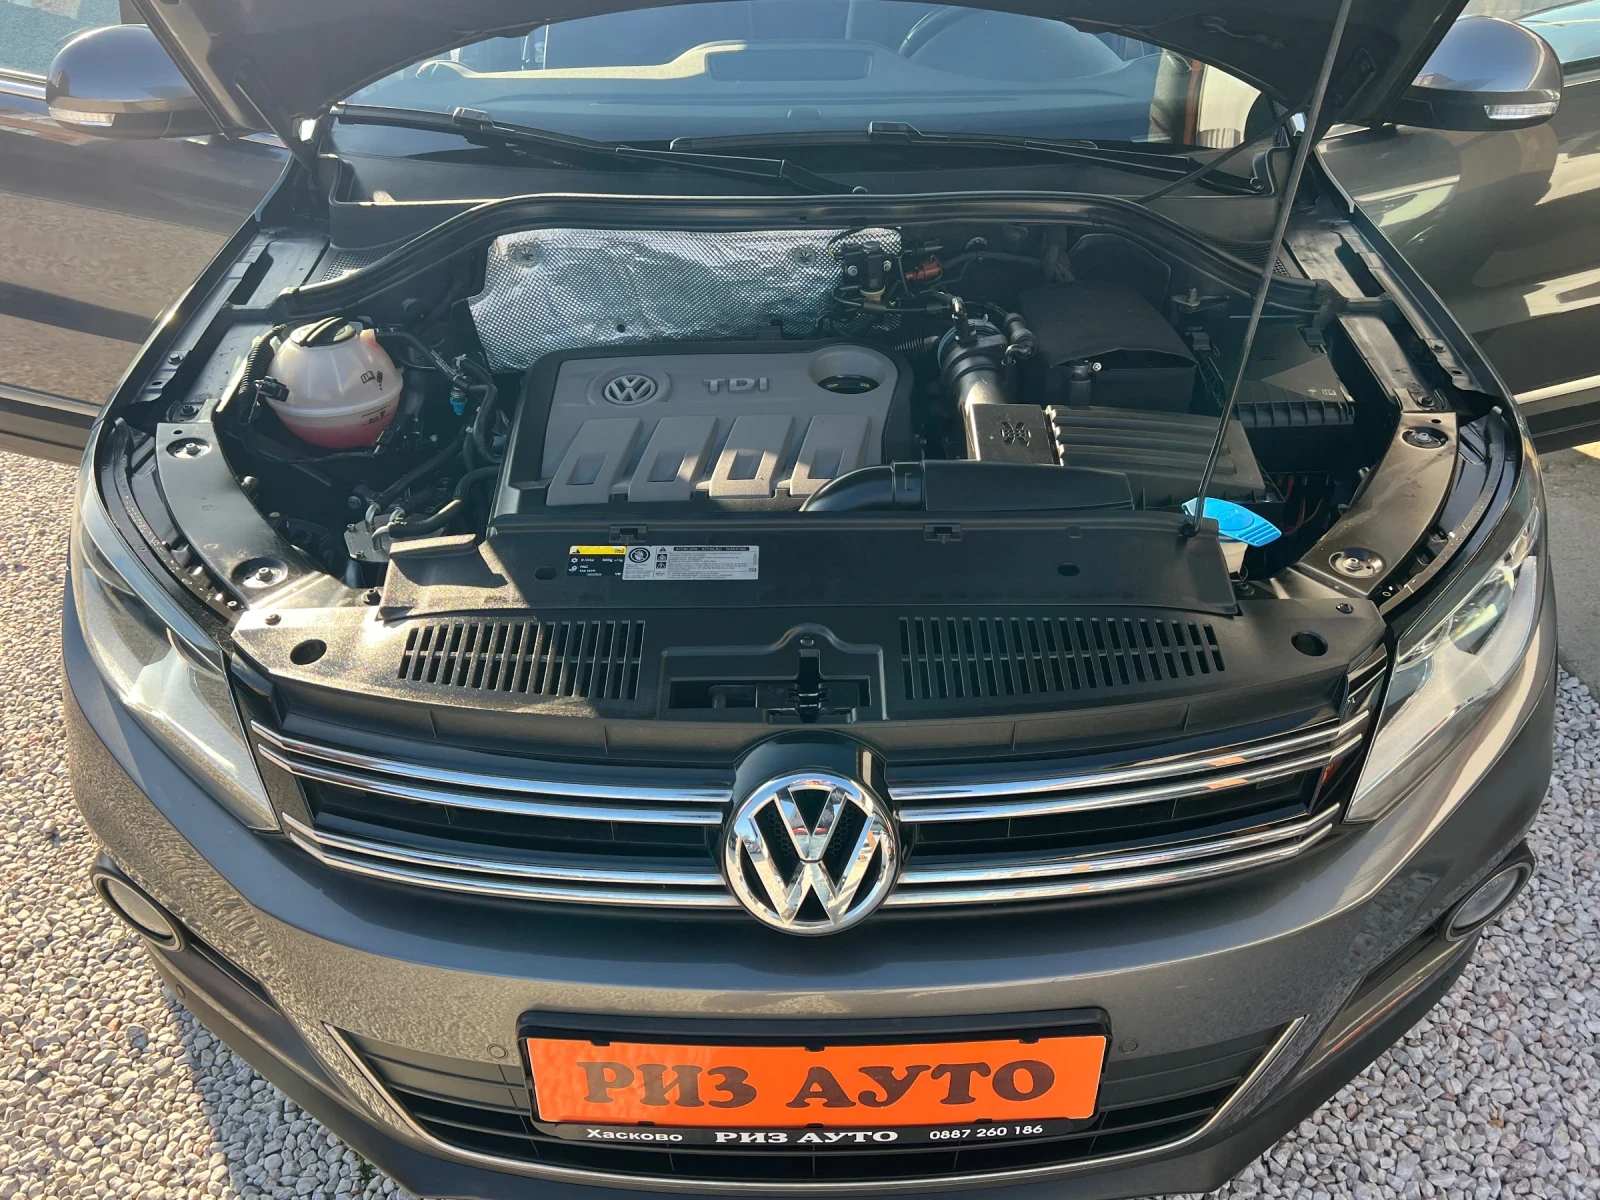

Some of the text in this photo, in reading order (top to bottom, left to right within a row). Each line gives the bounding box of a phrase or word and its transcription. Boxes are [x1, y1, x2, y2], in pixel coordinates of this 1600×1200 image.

[603, 374, 658, 405] VW
[703, 376, 770, 395] TDI
[725, 769, 899, 936] VW
[576, 1059, 1056, 1109] РИЗ АУТО
[586, 1124, 1044, 1144] Хасково РИЗ АУТО 0887 260 186
